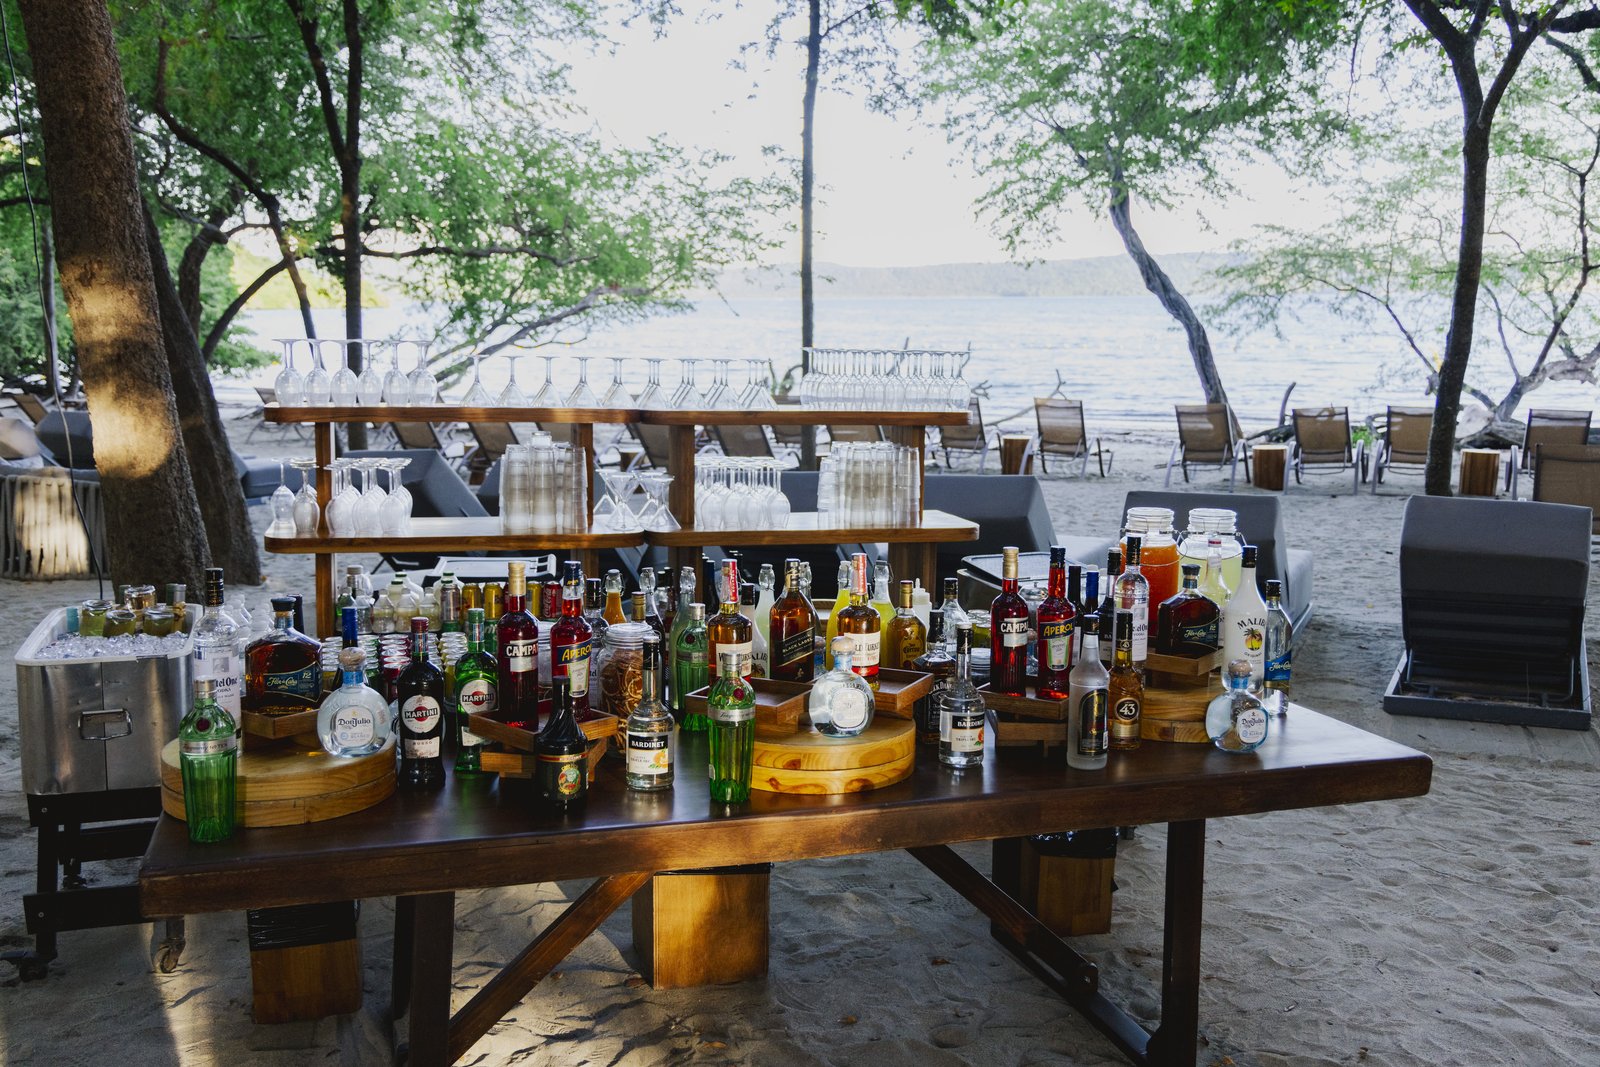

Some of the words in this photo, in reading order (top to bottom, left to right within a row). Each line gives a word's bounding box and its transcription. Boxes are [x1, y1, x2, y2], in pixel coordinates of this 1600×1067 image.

[1000, 622, 1028, 632] CAMPA
[1237, 618, 1265, 629] MALIB
[1043, 623, 1073, 636] APEROL
[506, 644, 538, 657] CAMPA
[562, 644, 592, 662] APEROL
[215, 678, 225, 688] tel
[225, 676, 238, 687] One
[267, 677, 281, 686] Flor
[463, 693, 493, 702] MARTINI
[405, 708, 438, 718] MARTINI
[1120, 704, 1135, 715] 43
